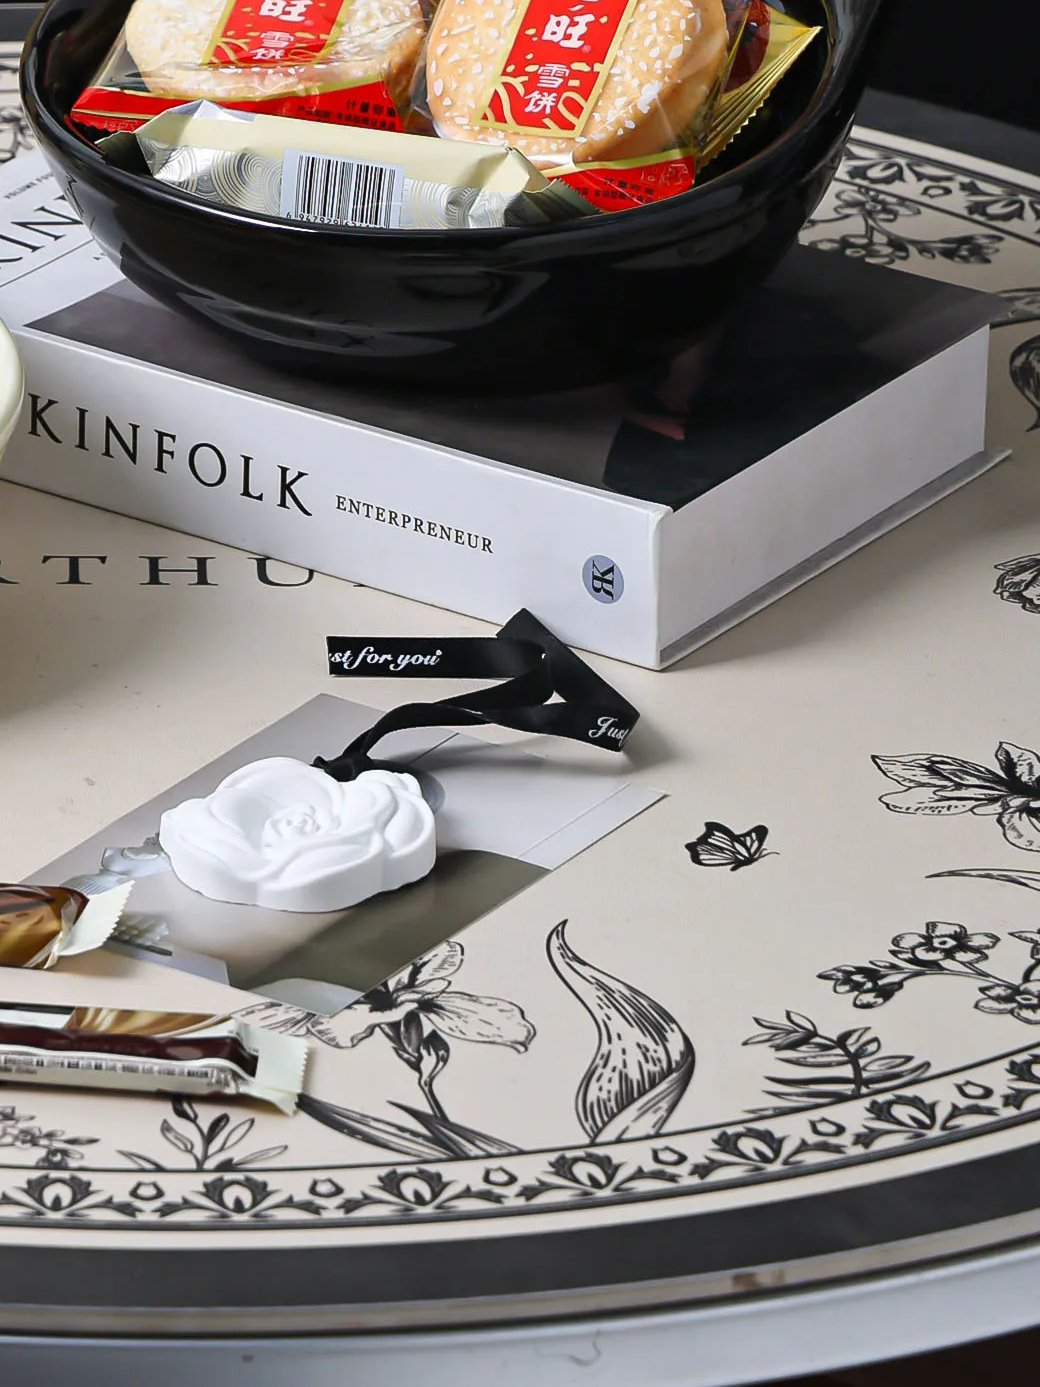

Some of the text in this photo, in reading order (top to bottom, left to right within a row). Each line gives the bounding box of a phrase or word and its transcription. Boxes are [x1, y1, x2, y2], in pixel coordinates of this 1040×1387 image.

[524, 63, 569, 114] 雪饼
[27, 392, 494, 554] KINFOLK ENTERPRENEUR
[328, 645, 442, 671] st for you
